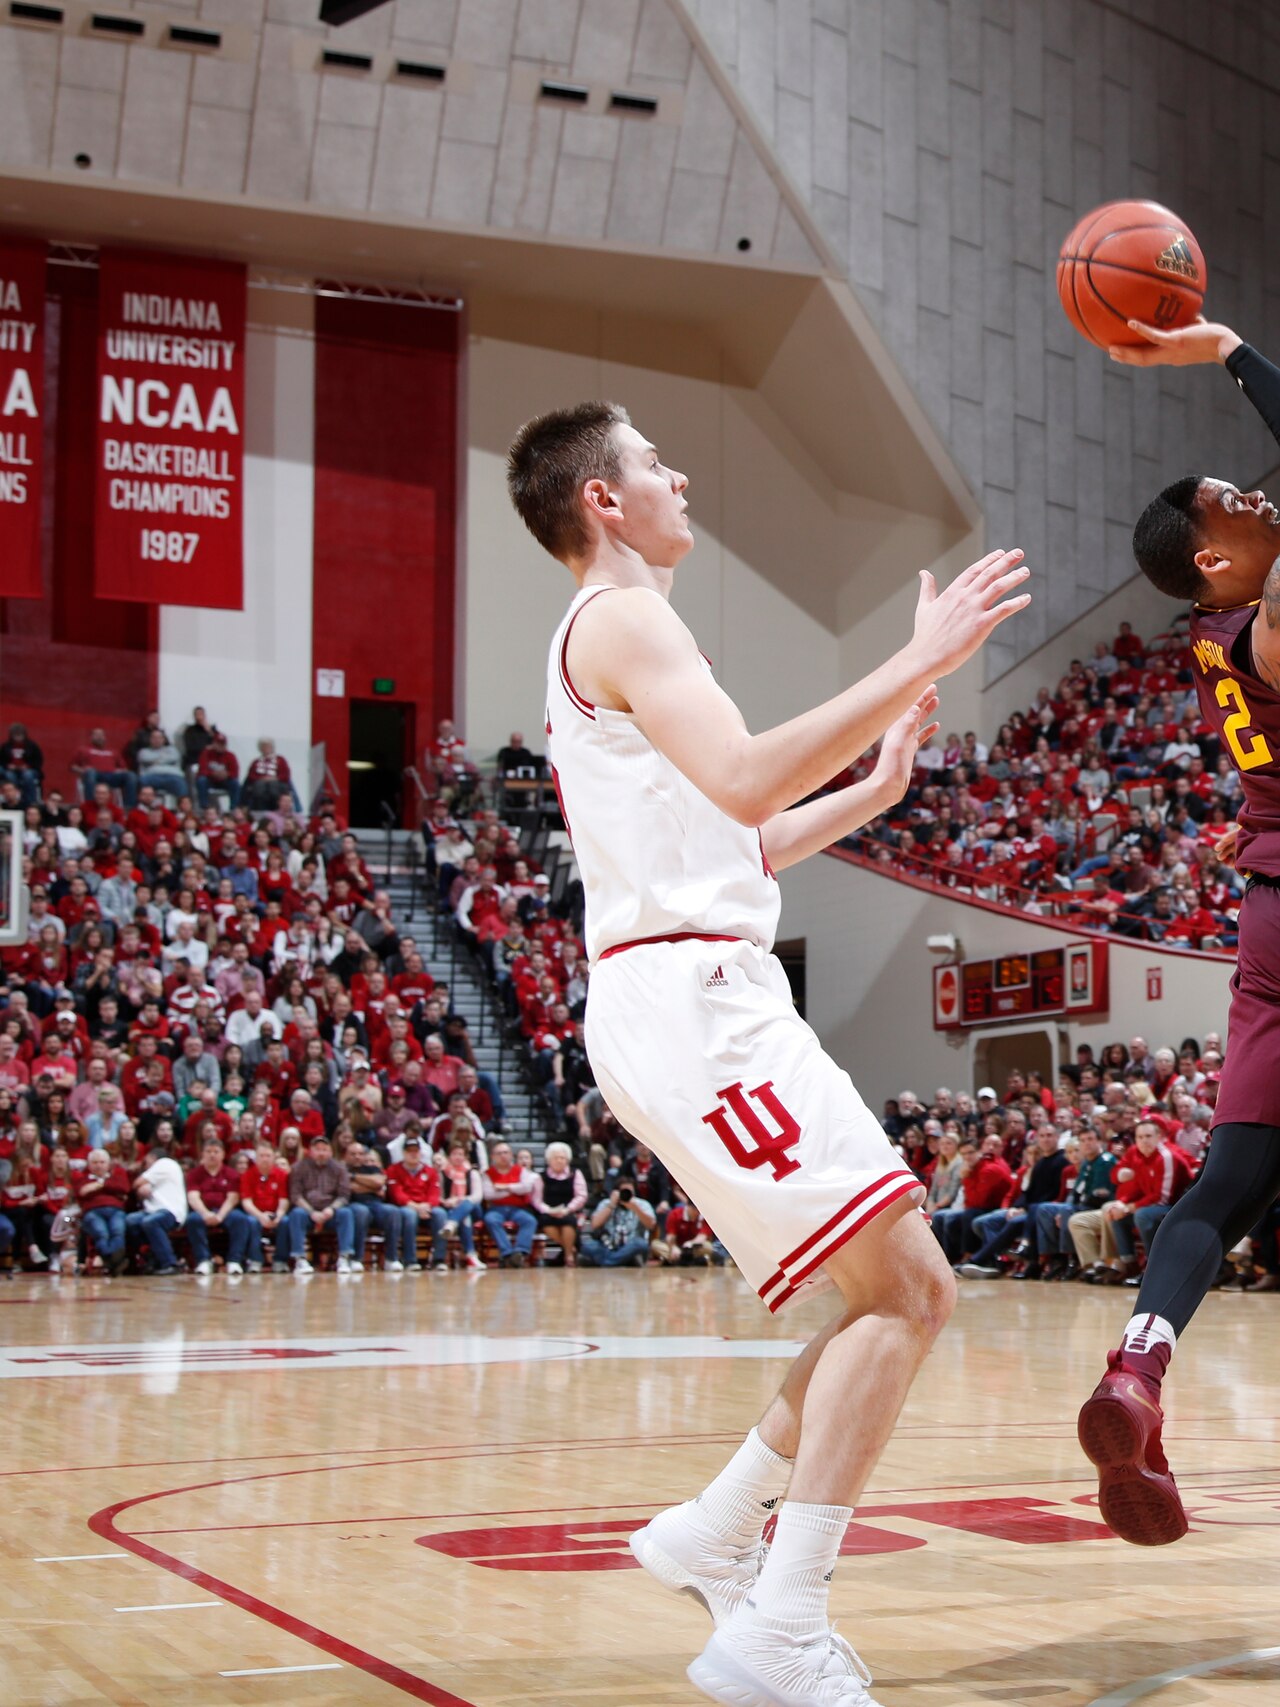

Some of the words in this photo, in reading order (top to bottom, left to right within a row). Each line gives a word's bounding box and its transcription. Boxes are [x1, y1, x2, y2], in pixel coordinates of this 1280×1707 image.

[1155, 257, 1199, 280] adidas
[123, 292, 221, 332] INDIANA
[106, 329, 235, 371] UNIVERSITY
[3, 368, 39, 418] A
[101, 375, 239, 435] NCAA
[104, 439, 235, 481] BASKETBALL
[110, 478, 229, 518] CHAMPIONS
[141, 529, 199, 563] 1987
[1215, 677, 1273, 771] 2
[706, 978, 728, 987] adidas
[702, 1081, 801, 1182] IU
